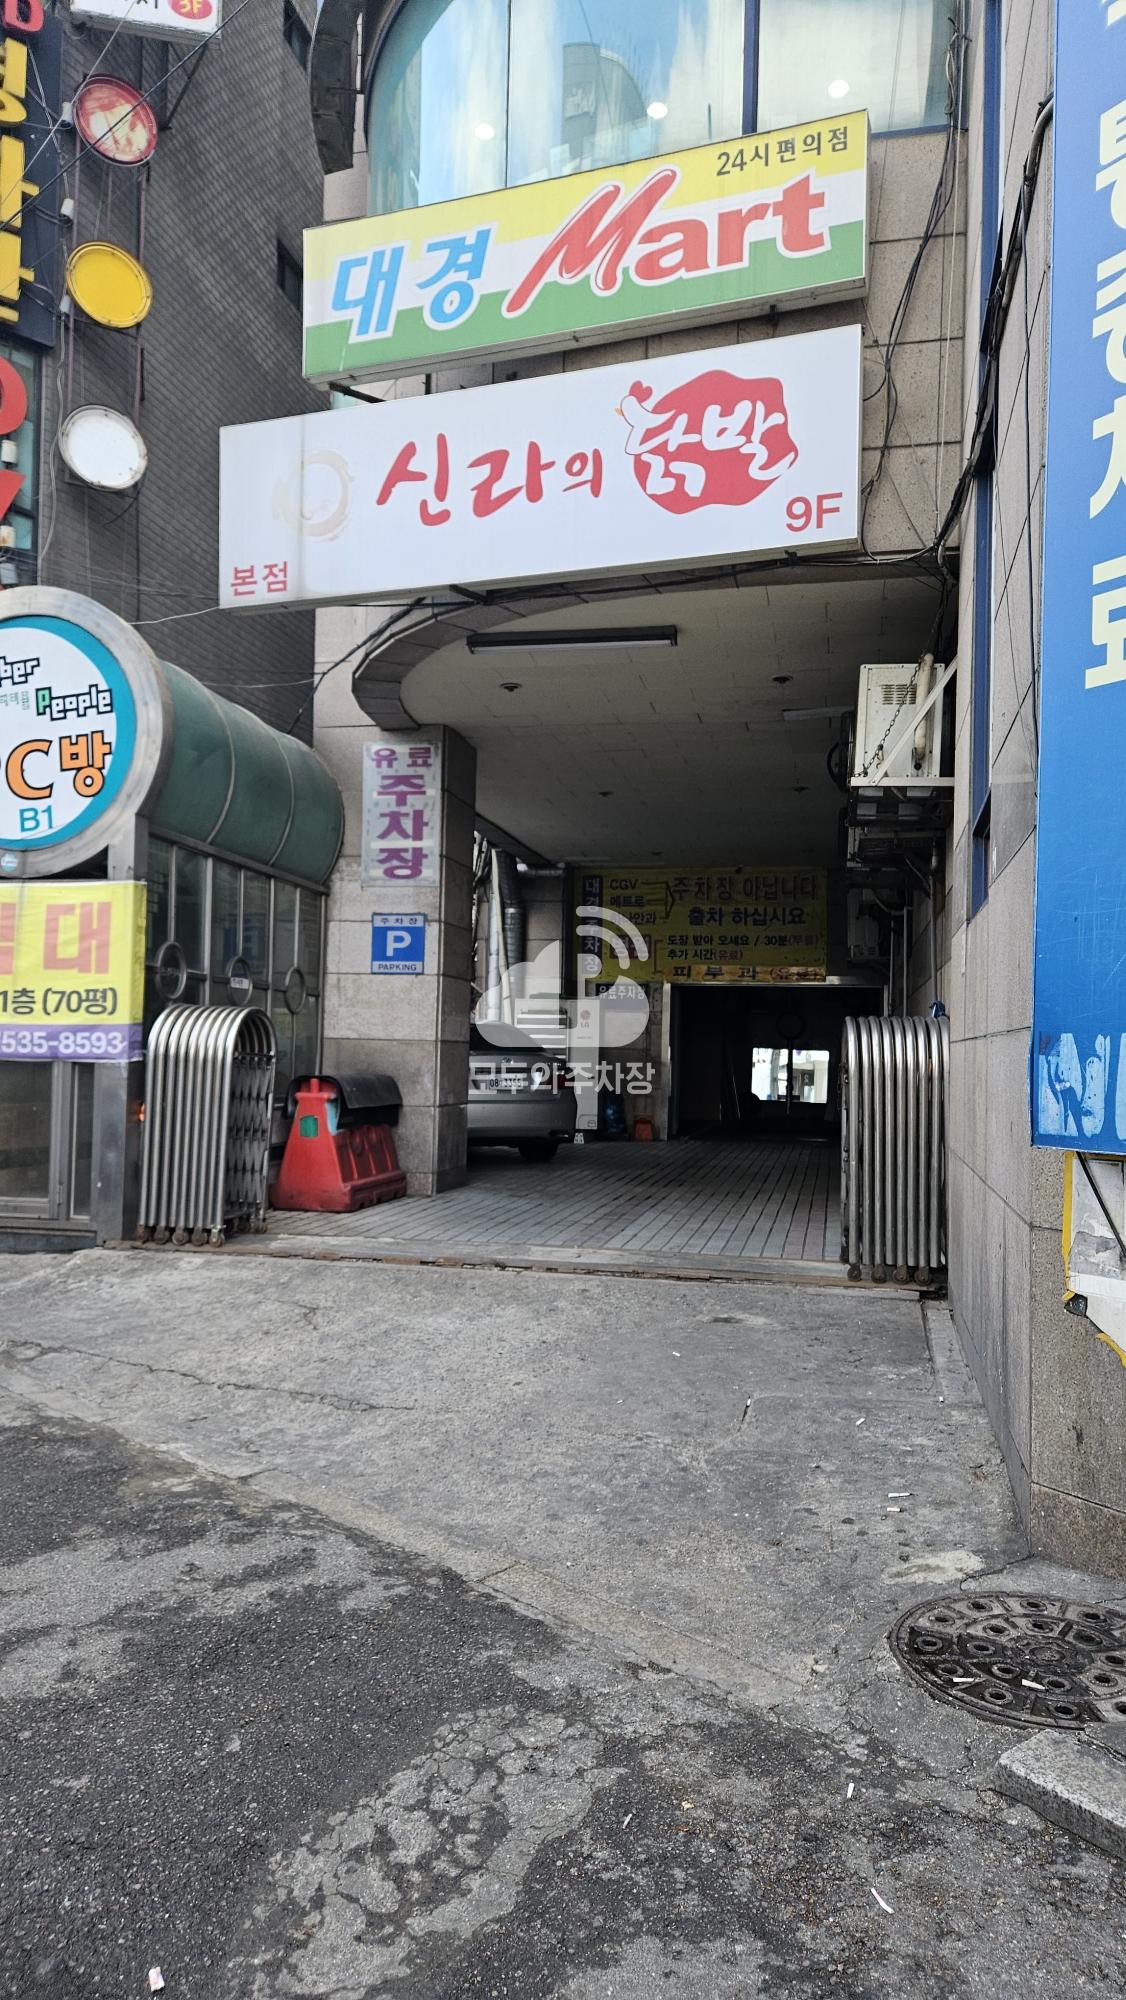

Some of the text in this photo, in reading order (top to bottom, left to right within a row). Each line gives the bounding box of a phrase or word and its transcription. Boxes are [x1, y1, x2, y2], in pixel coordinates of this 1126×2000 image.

[716, 126, 850, 177] 24시편의점
[331, 167, 826, 337] 대경 Mart
[375, 396, 799, 526] 신라의 닭발
[784, 492, 844, 533] 9F
[230, 562, 289, 597] 본점
[35, 683, 113, 721] People
[0, 730, 112, 800] C방
[371, 747, 433, 768] 유료
[19, 805, 53, 832] B1
[609, 875, 818, 902] CGV 주차장 아닙니다
[688, 906, 806, 926] 출차 하십시요
[386, 930, 412, 957] P
[667, 935, 689, 946] 도장
[718, 935, 750, 947] 오세요
[667, 948, 689, 960] 추가
[377, 963, 417, 972] PARKING
[42, 987, 118, 1015] (70평)
